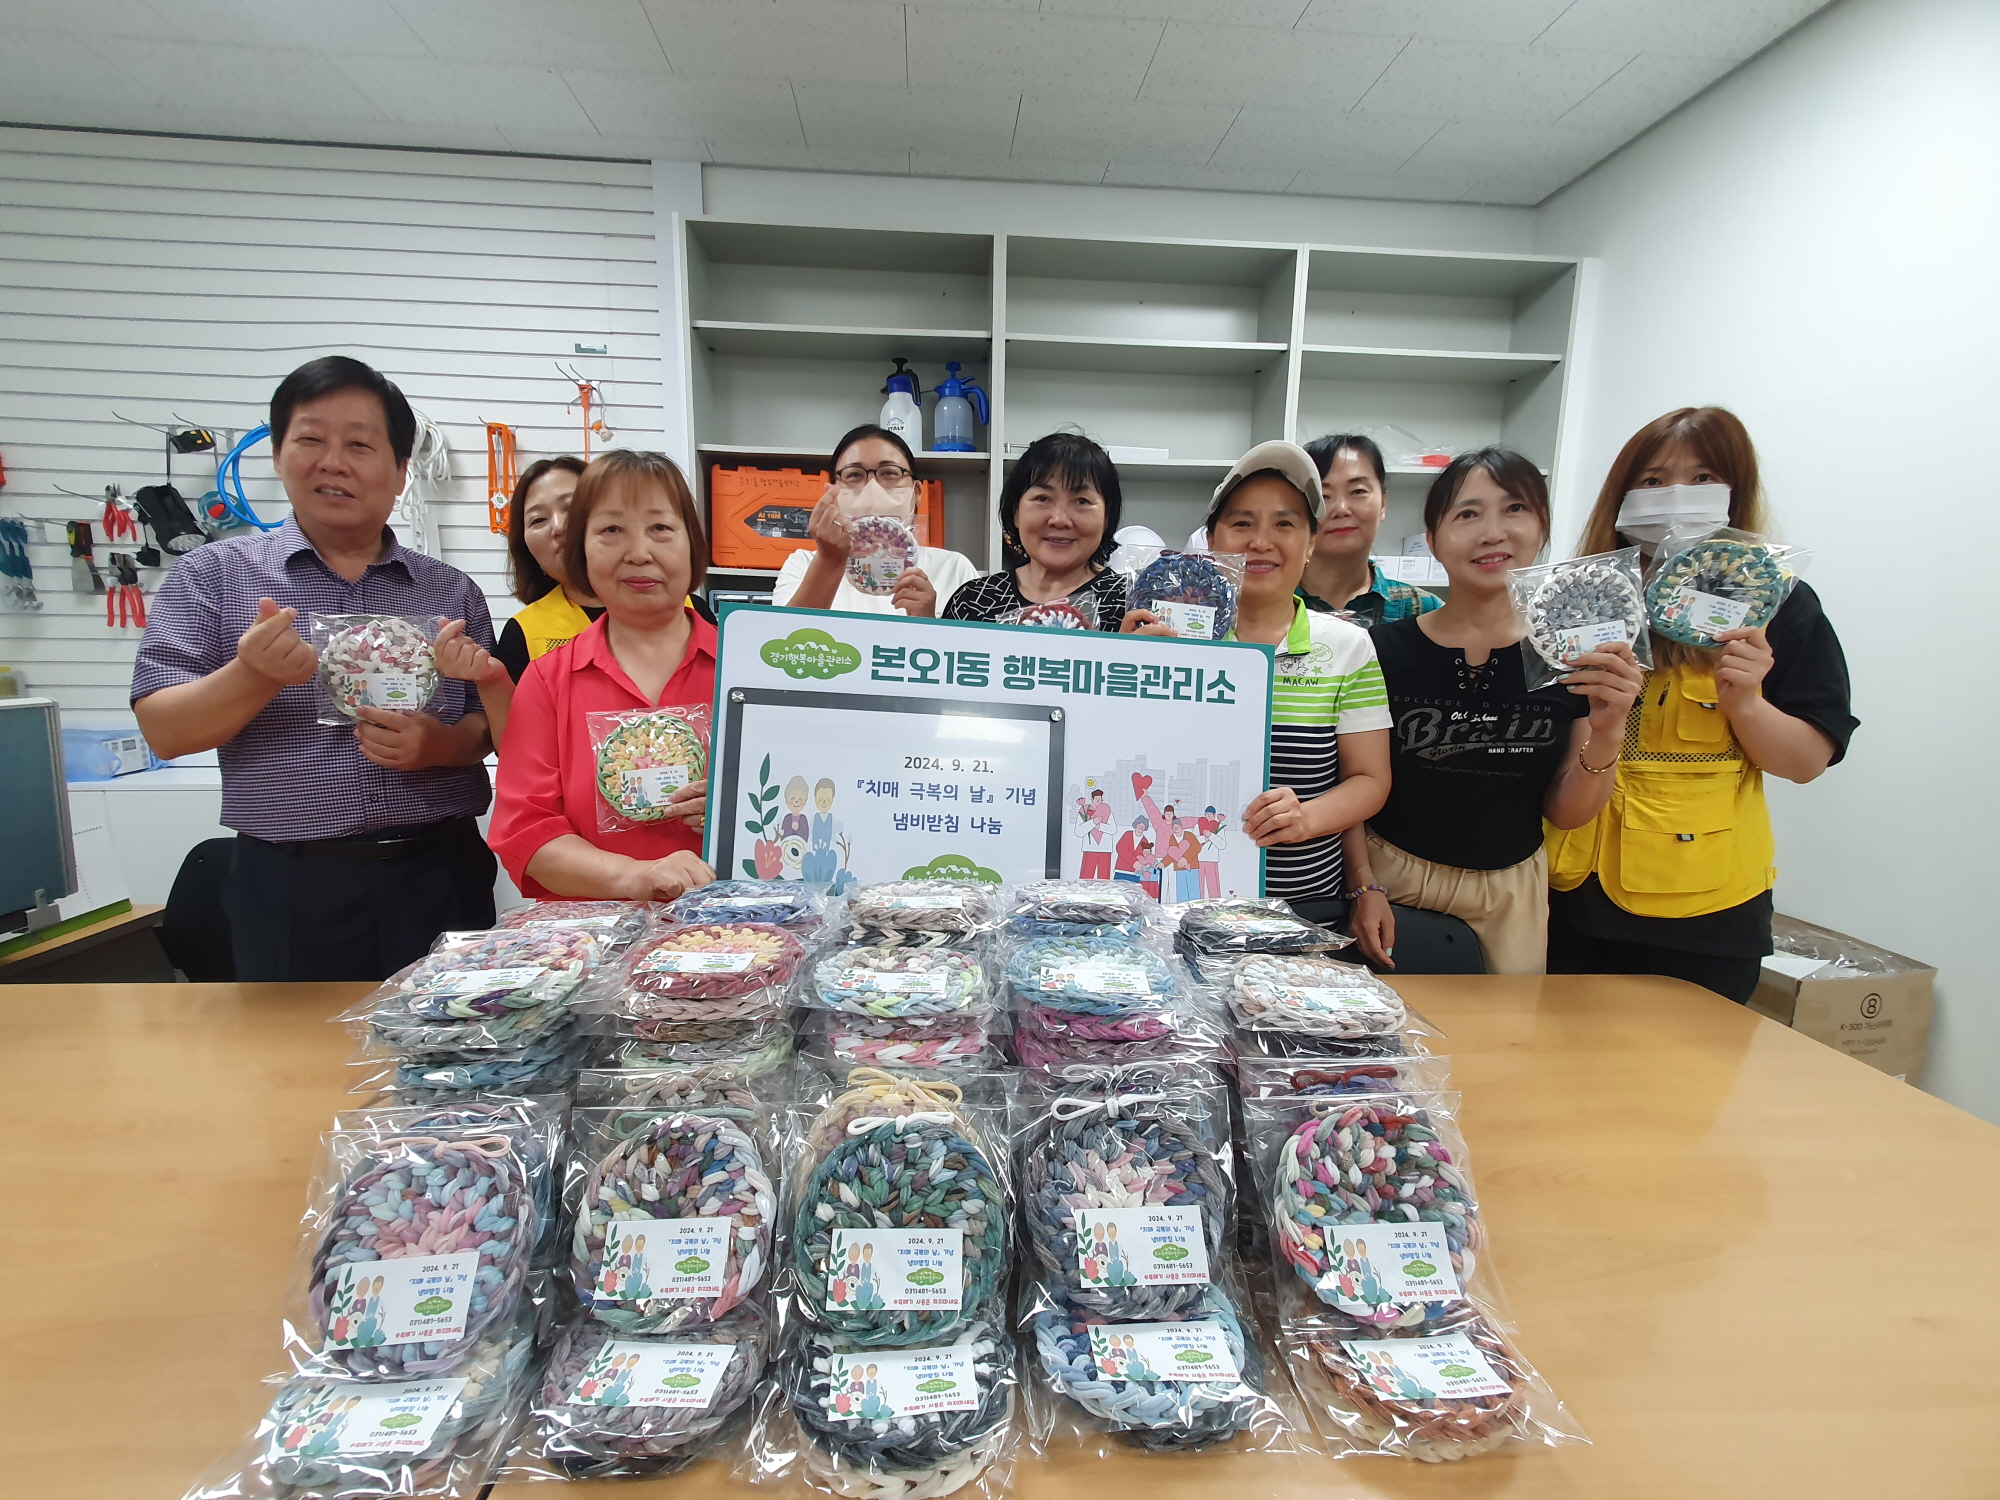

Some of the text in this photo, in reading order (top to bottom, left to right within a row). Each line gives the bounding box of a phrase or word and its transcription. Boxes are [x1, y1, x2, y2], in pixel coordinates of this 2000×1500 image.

[769, 652, 852, 668] 경기행복마을관리소
[871, 644, 1236, 705] 본오1동 행복마을관리소
[1283, 677, 1319, 686] MACAW
[1397, 708, 1552, 755] Brain
[904, 756, 994, 773] 2024. 9. 21.
[910, 782, 958, 801] 극복의
[1005, 787, 1036, 806] 기념
[893, 813, 1003, 835] 냄비받침 나눔
